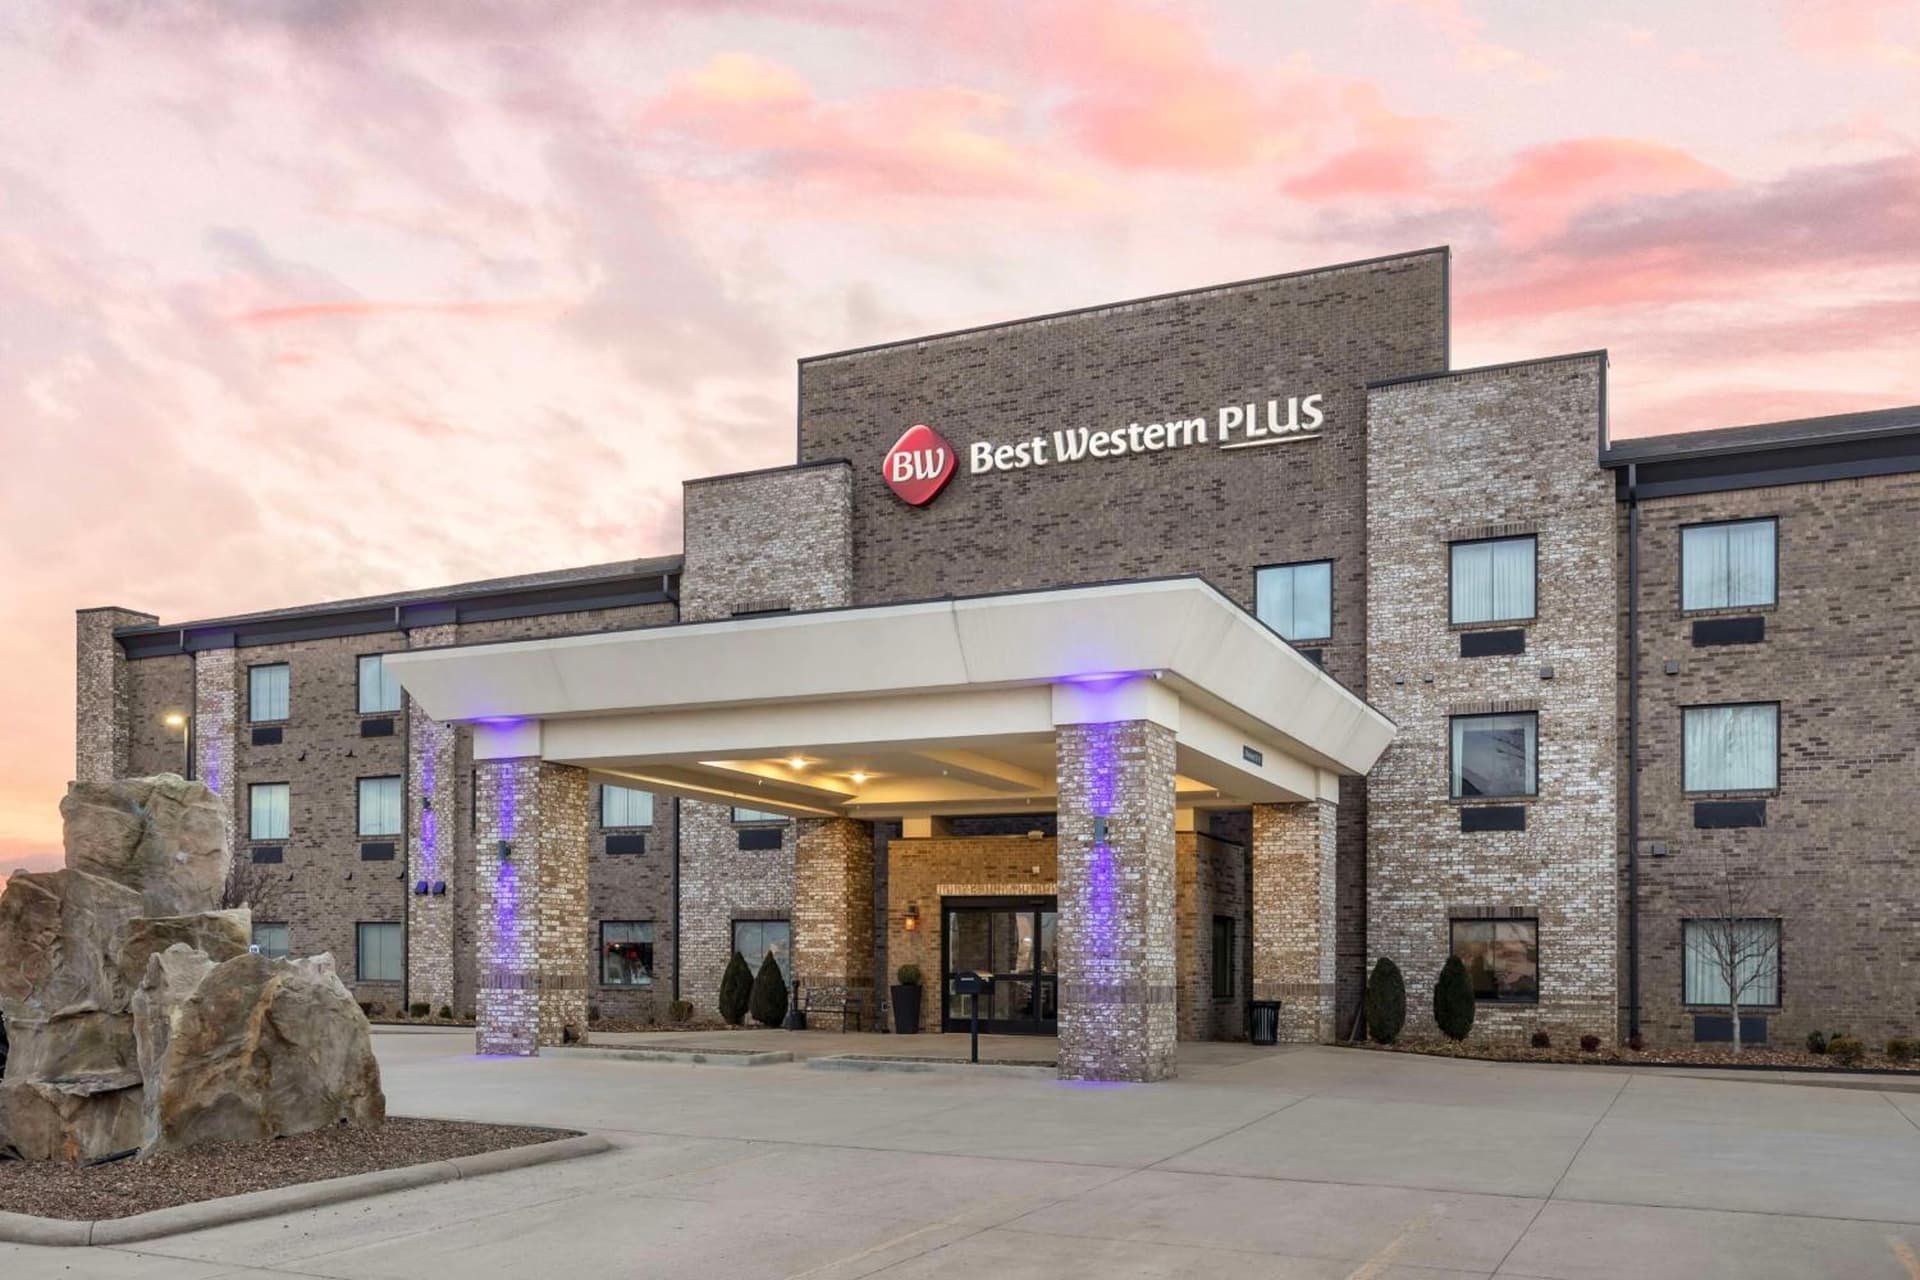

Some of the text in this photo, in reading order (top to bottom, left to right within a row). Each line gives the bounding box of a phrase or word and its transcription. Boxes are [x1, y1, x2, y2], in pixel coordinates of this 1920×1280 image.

[970, 393, 1324, 474] Best Western PLUS
[892, 447, 945, 482] BW
